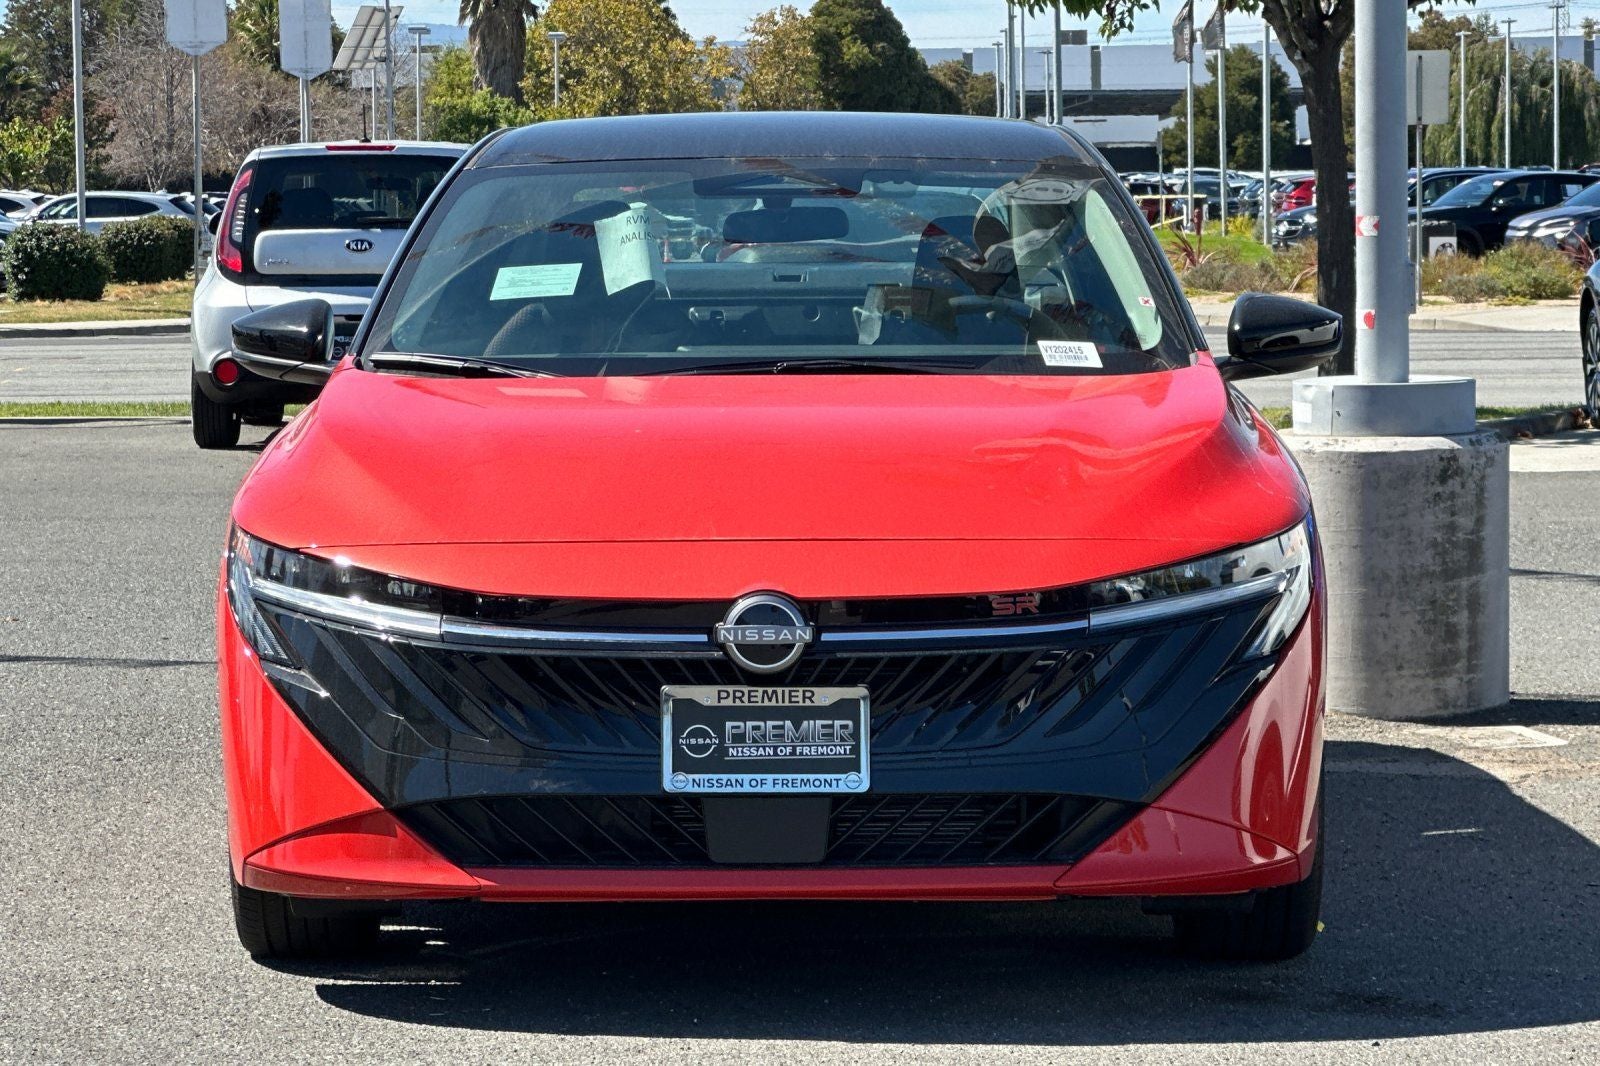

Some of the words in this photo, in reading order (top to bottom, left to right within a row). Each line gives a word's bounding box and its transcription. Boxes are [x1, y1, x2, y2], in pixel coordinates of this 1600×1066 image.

[626, 215, 650, 226] RVM
[349, 241, 370, 250] KIA
[1042, 345, 1084, 355] VY202415
[992, 596, 1039, 616] SR
[720, 628, 811, 642] NISSAN
[717, 689, 815, 705] PREMIER
[725, 720, 855, 744] PREMIER
[728, 746, 775, 757] NISSAN
[778, 746, 793, 756] OF
[795, 745, 852, 756] FREMONT
[692, 778, 744, 789] NISSAN
[749, 778, 768, 789] OF
[772, 778, 842, 789] FREMONT
